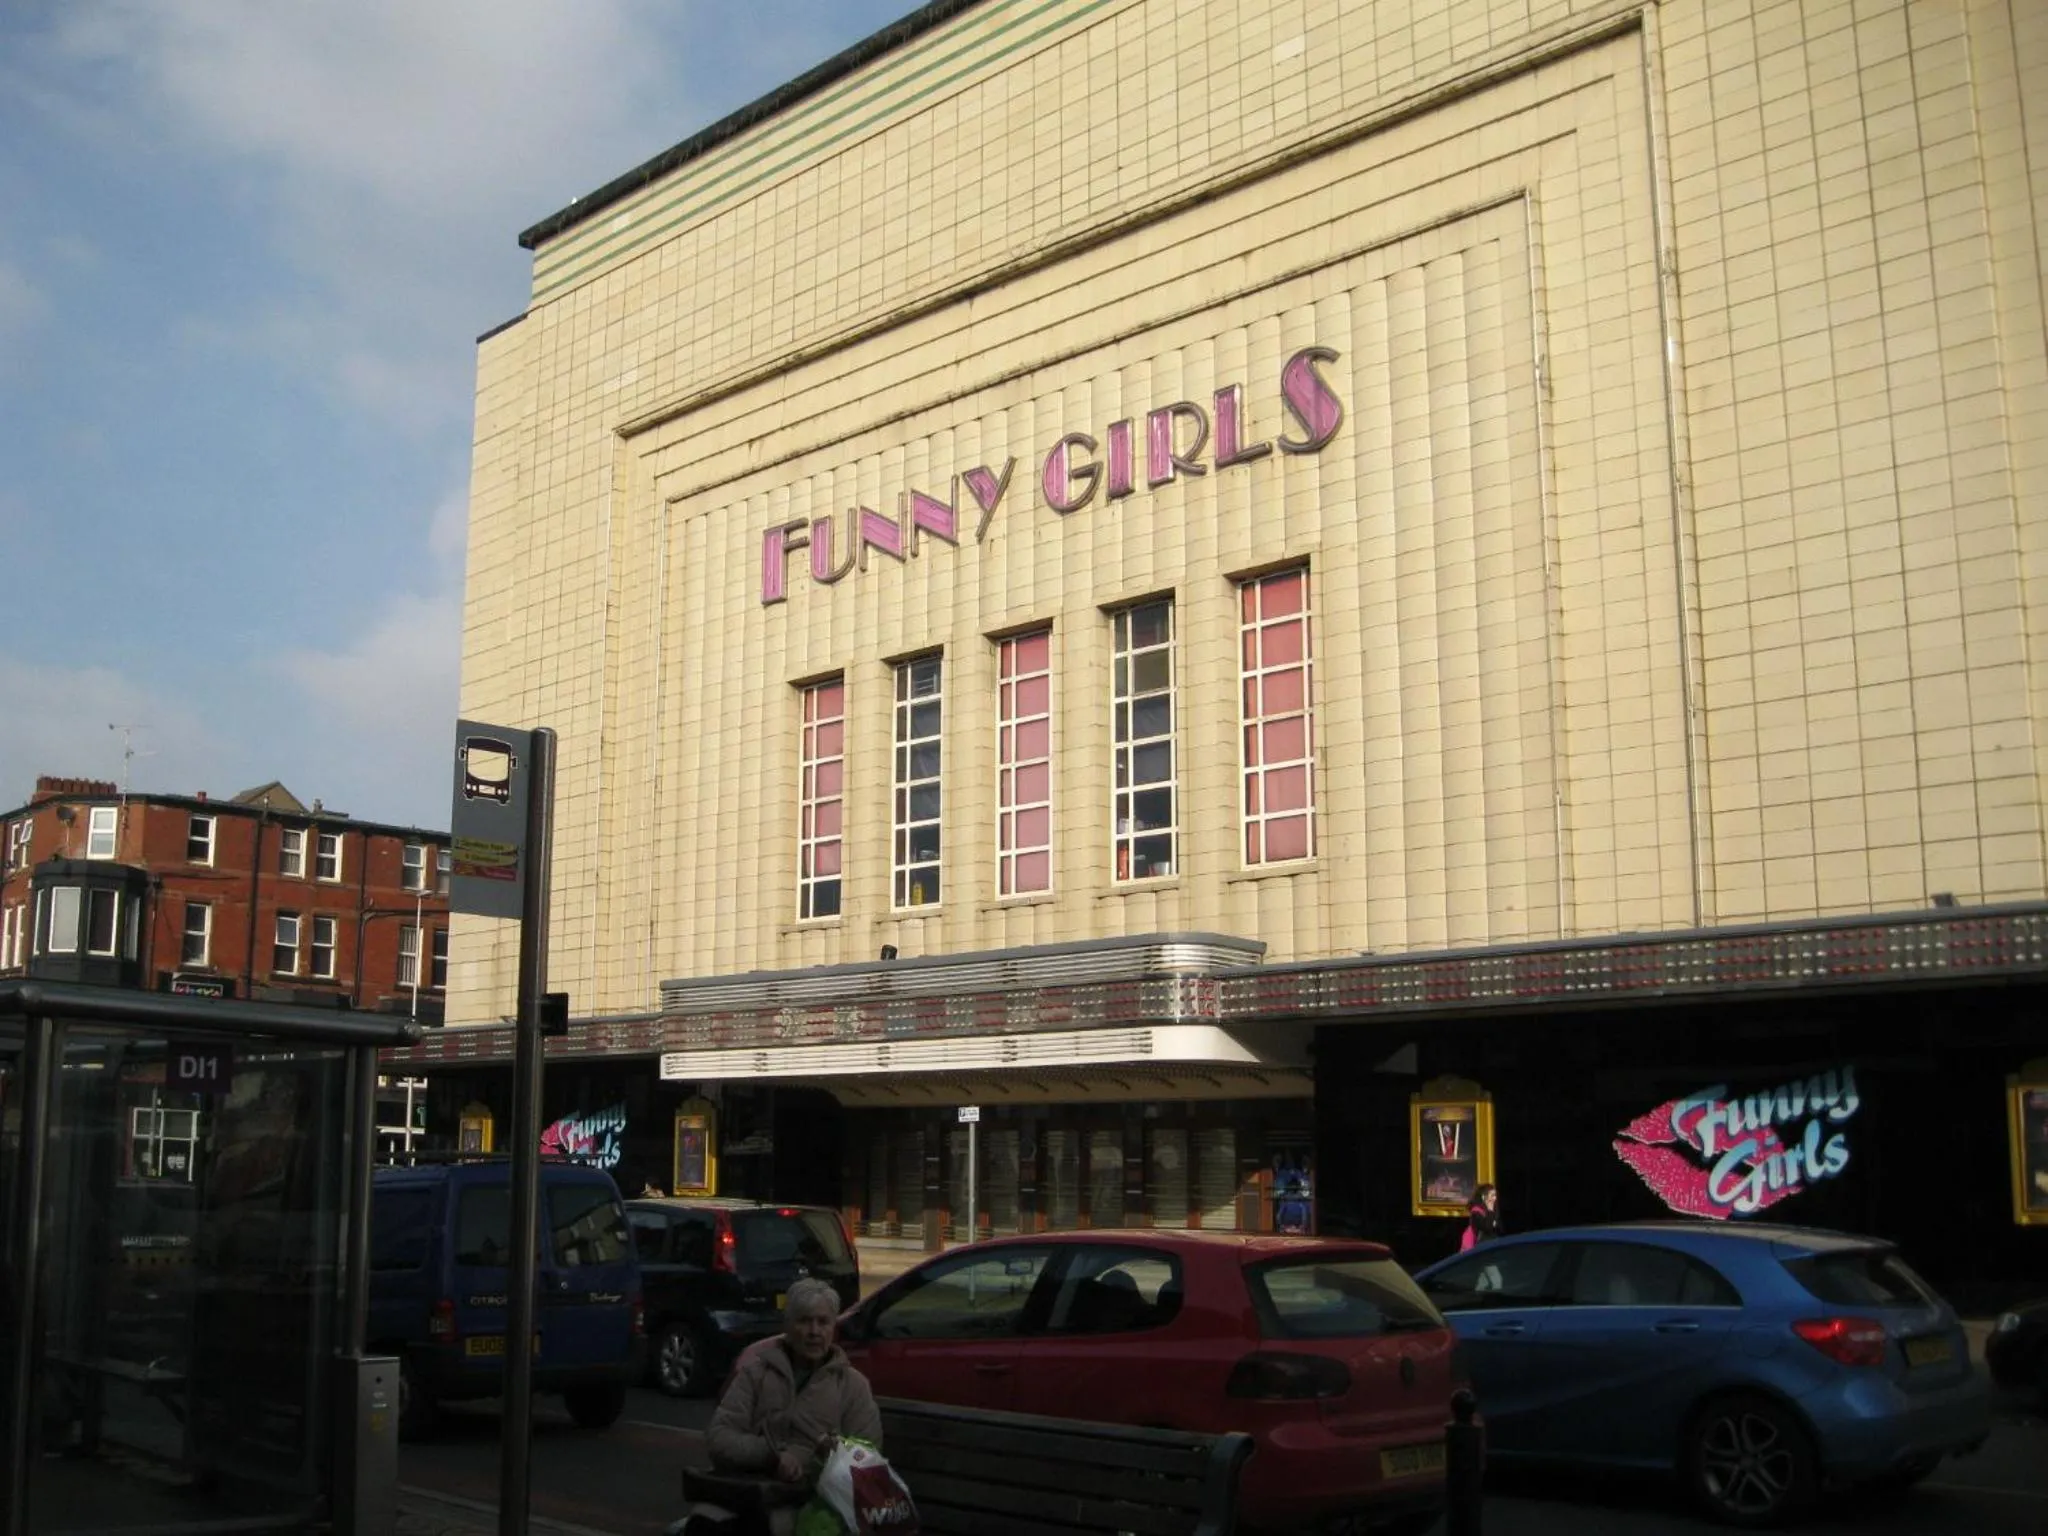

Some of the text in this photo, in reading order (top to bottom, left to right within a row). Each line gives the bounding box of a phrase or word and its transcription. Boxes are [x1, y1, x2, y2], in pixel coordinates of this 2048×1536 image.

[760, 345, 1345, 608] FUNNY GIRLS
[179, 1055, 219, 1080] DI1
[557, 1101, 626, 1155] Funny
[1670, 1065, 1860, 1159] Funny
[573, 1131, 621, 1169] rls
[1708, 1118, 1850, 1213] Girls
